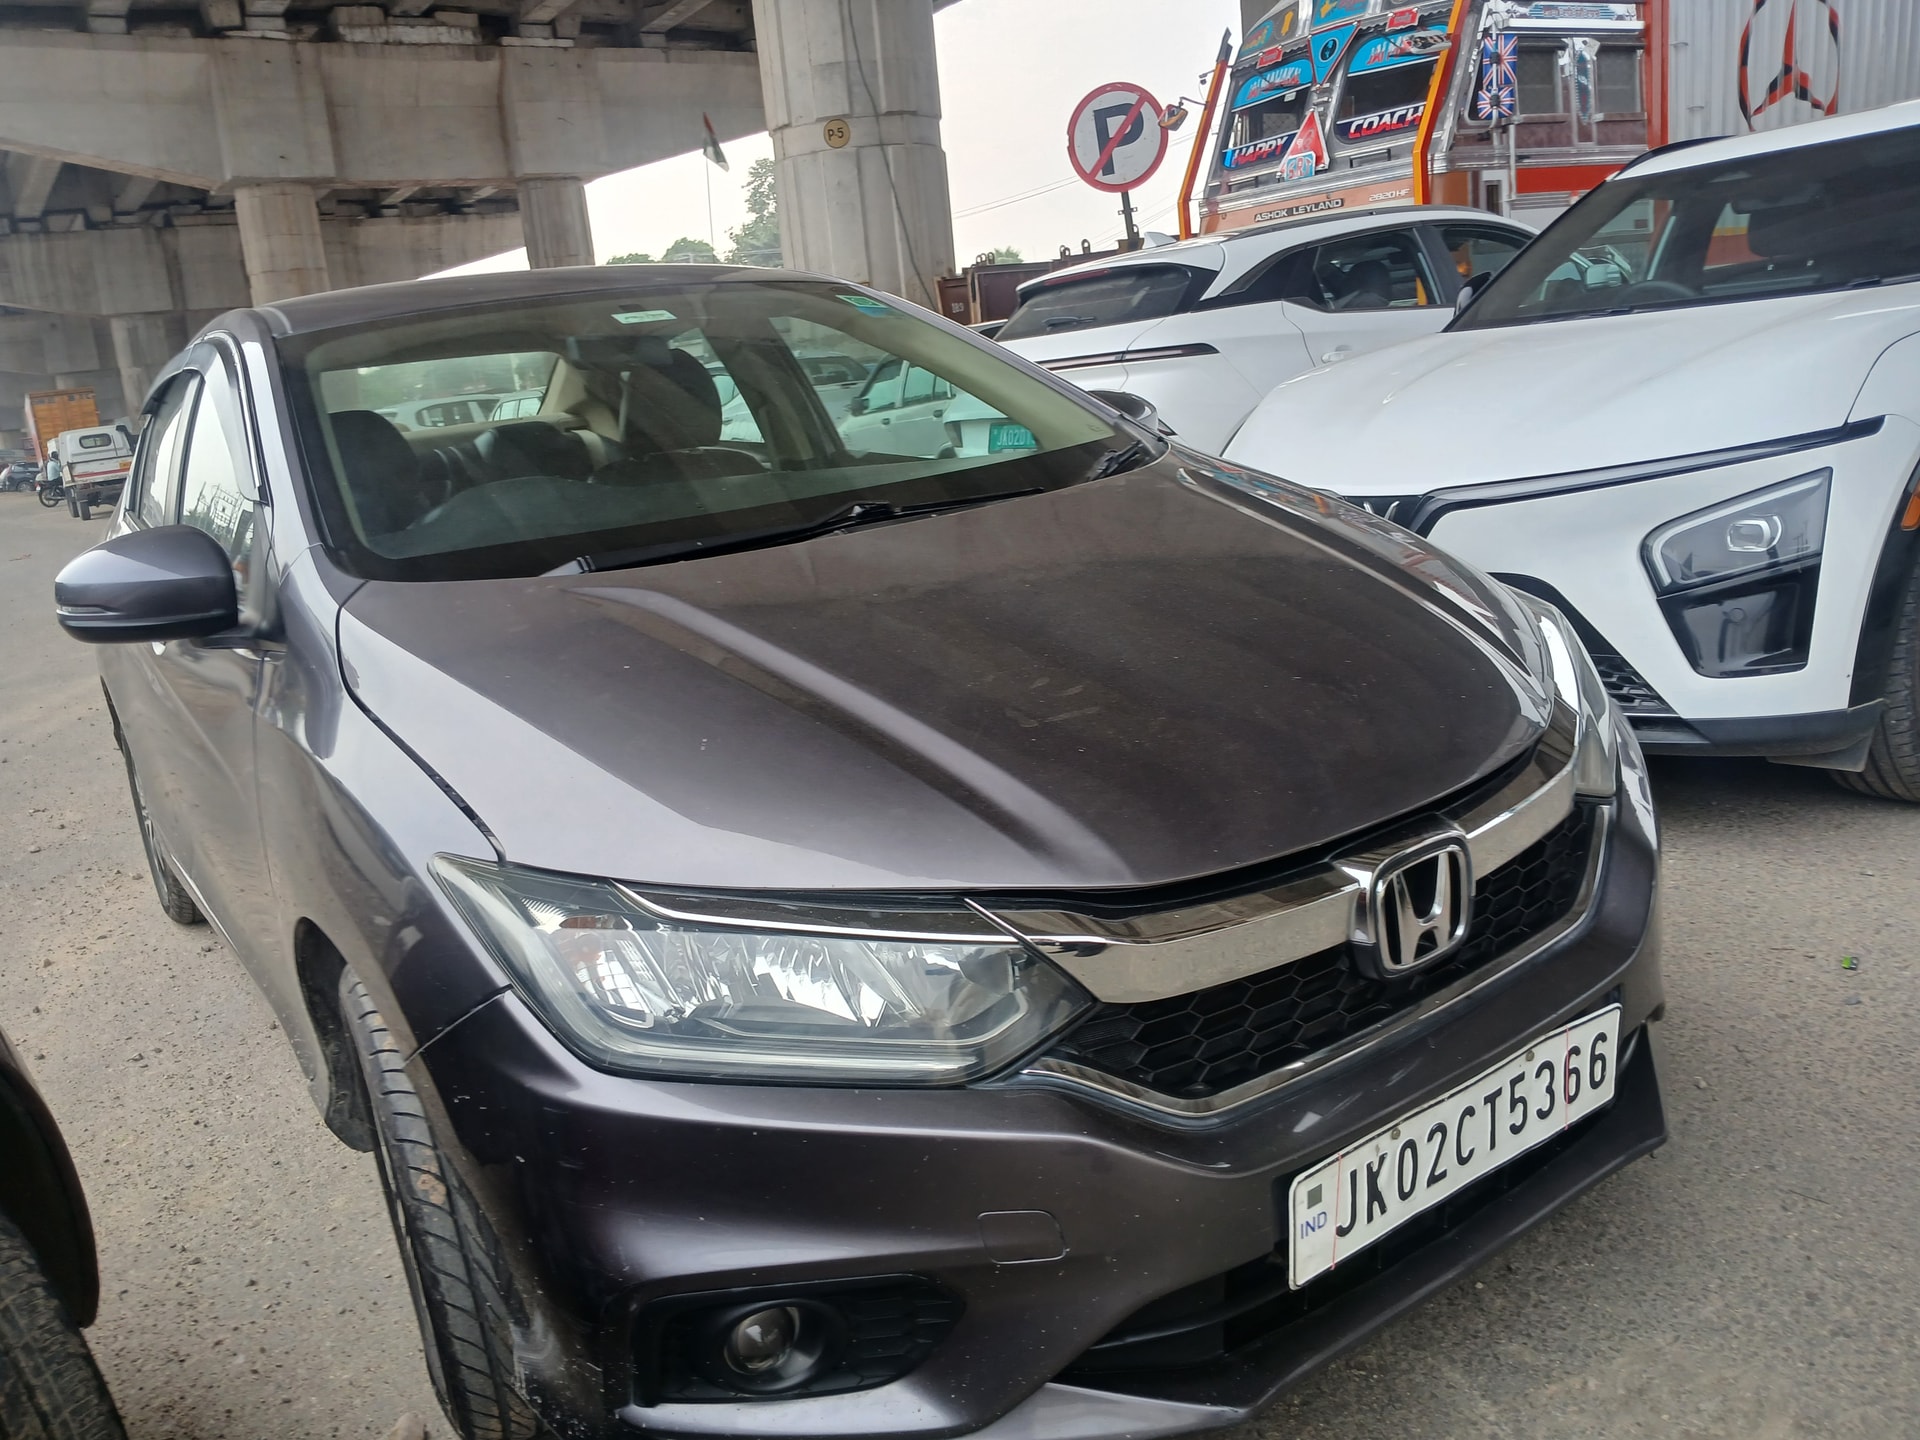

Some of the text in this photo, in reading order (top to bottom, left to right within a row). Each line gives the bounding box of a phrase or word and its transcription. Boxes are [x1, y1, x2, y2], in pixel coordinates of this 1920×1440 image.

[1348, 105, 1425, 138] COACH
[1093, 102, 1144, 176] P
[1231, 136, 1289, 166] HAPPY
[1255, 199, 1342, 222] ASHOK LEYLAND
[1335, 1031, 1608, 1239] JK02CT5366
[1300, 1211, 1328, 1240] IND
